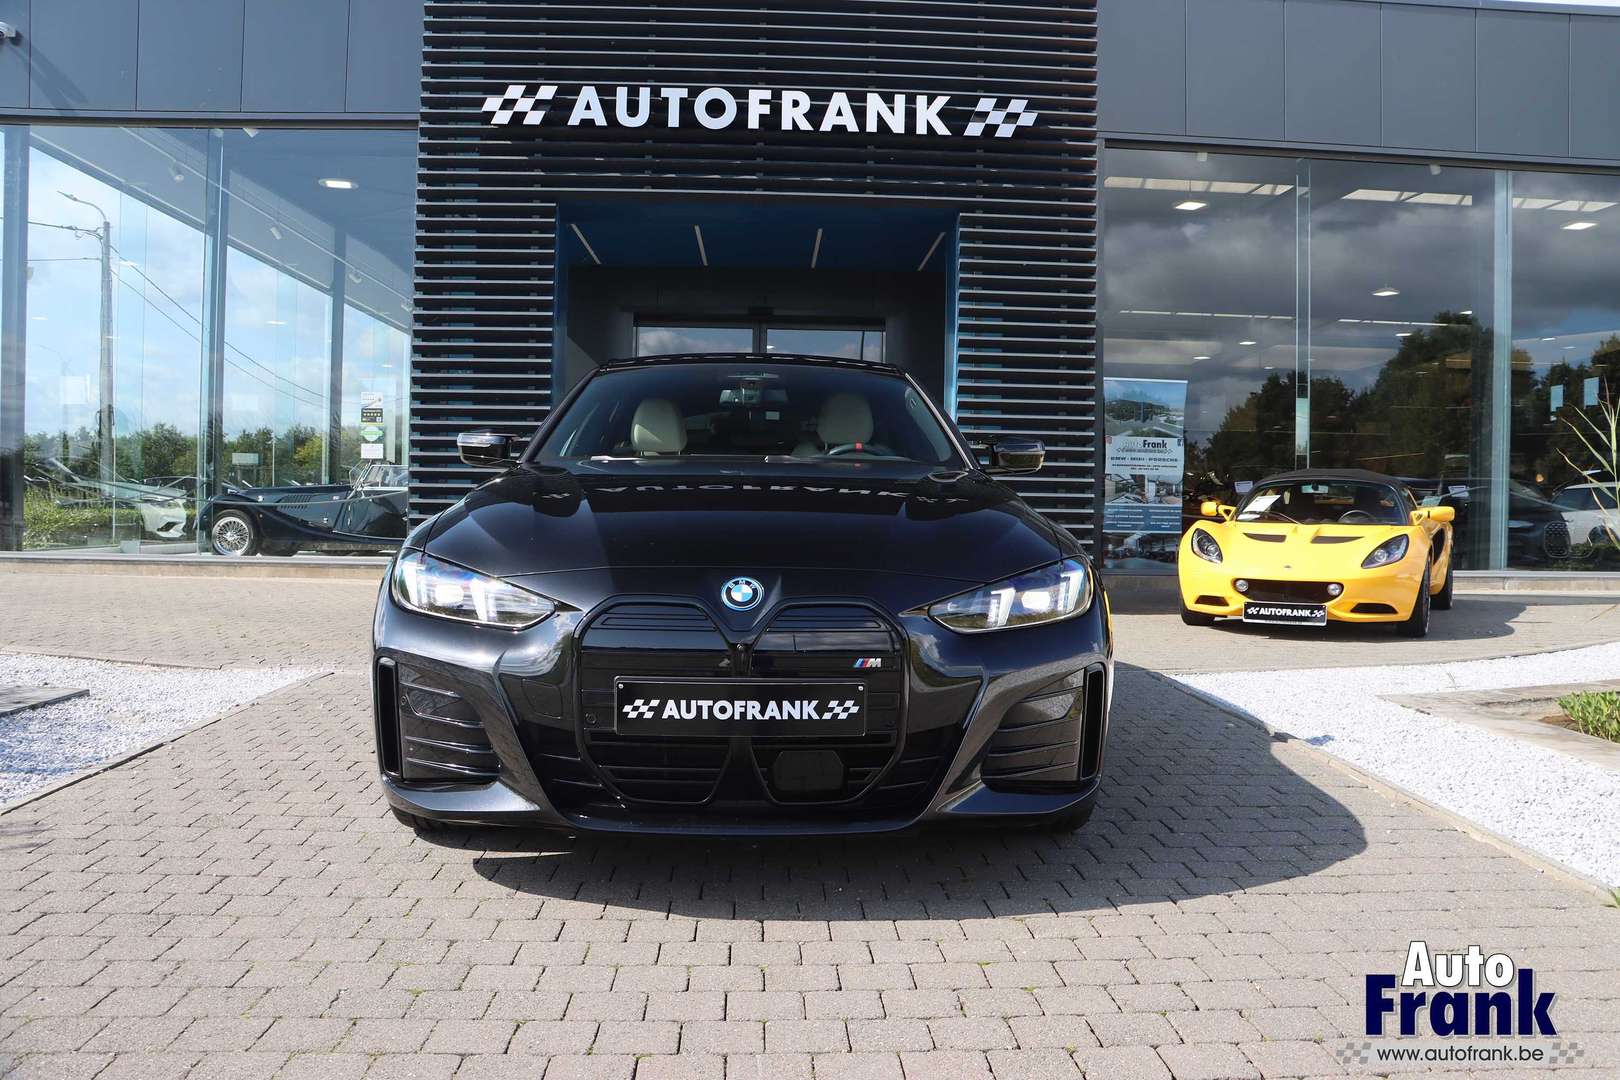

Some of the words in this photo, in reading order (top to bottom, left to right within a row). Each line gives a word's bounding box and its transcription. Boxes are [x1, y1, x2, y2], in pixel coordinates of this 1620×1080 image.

[567, 86, 952, 137] AUTOFRANK
[1260, 608, 1311, 617] AUTOFRANK
[662, 699, 821, 721] AUTOFRANK
